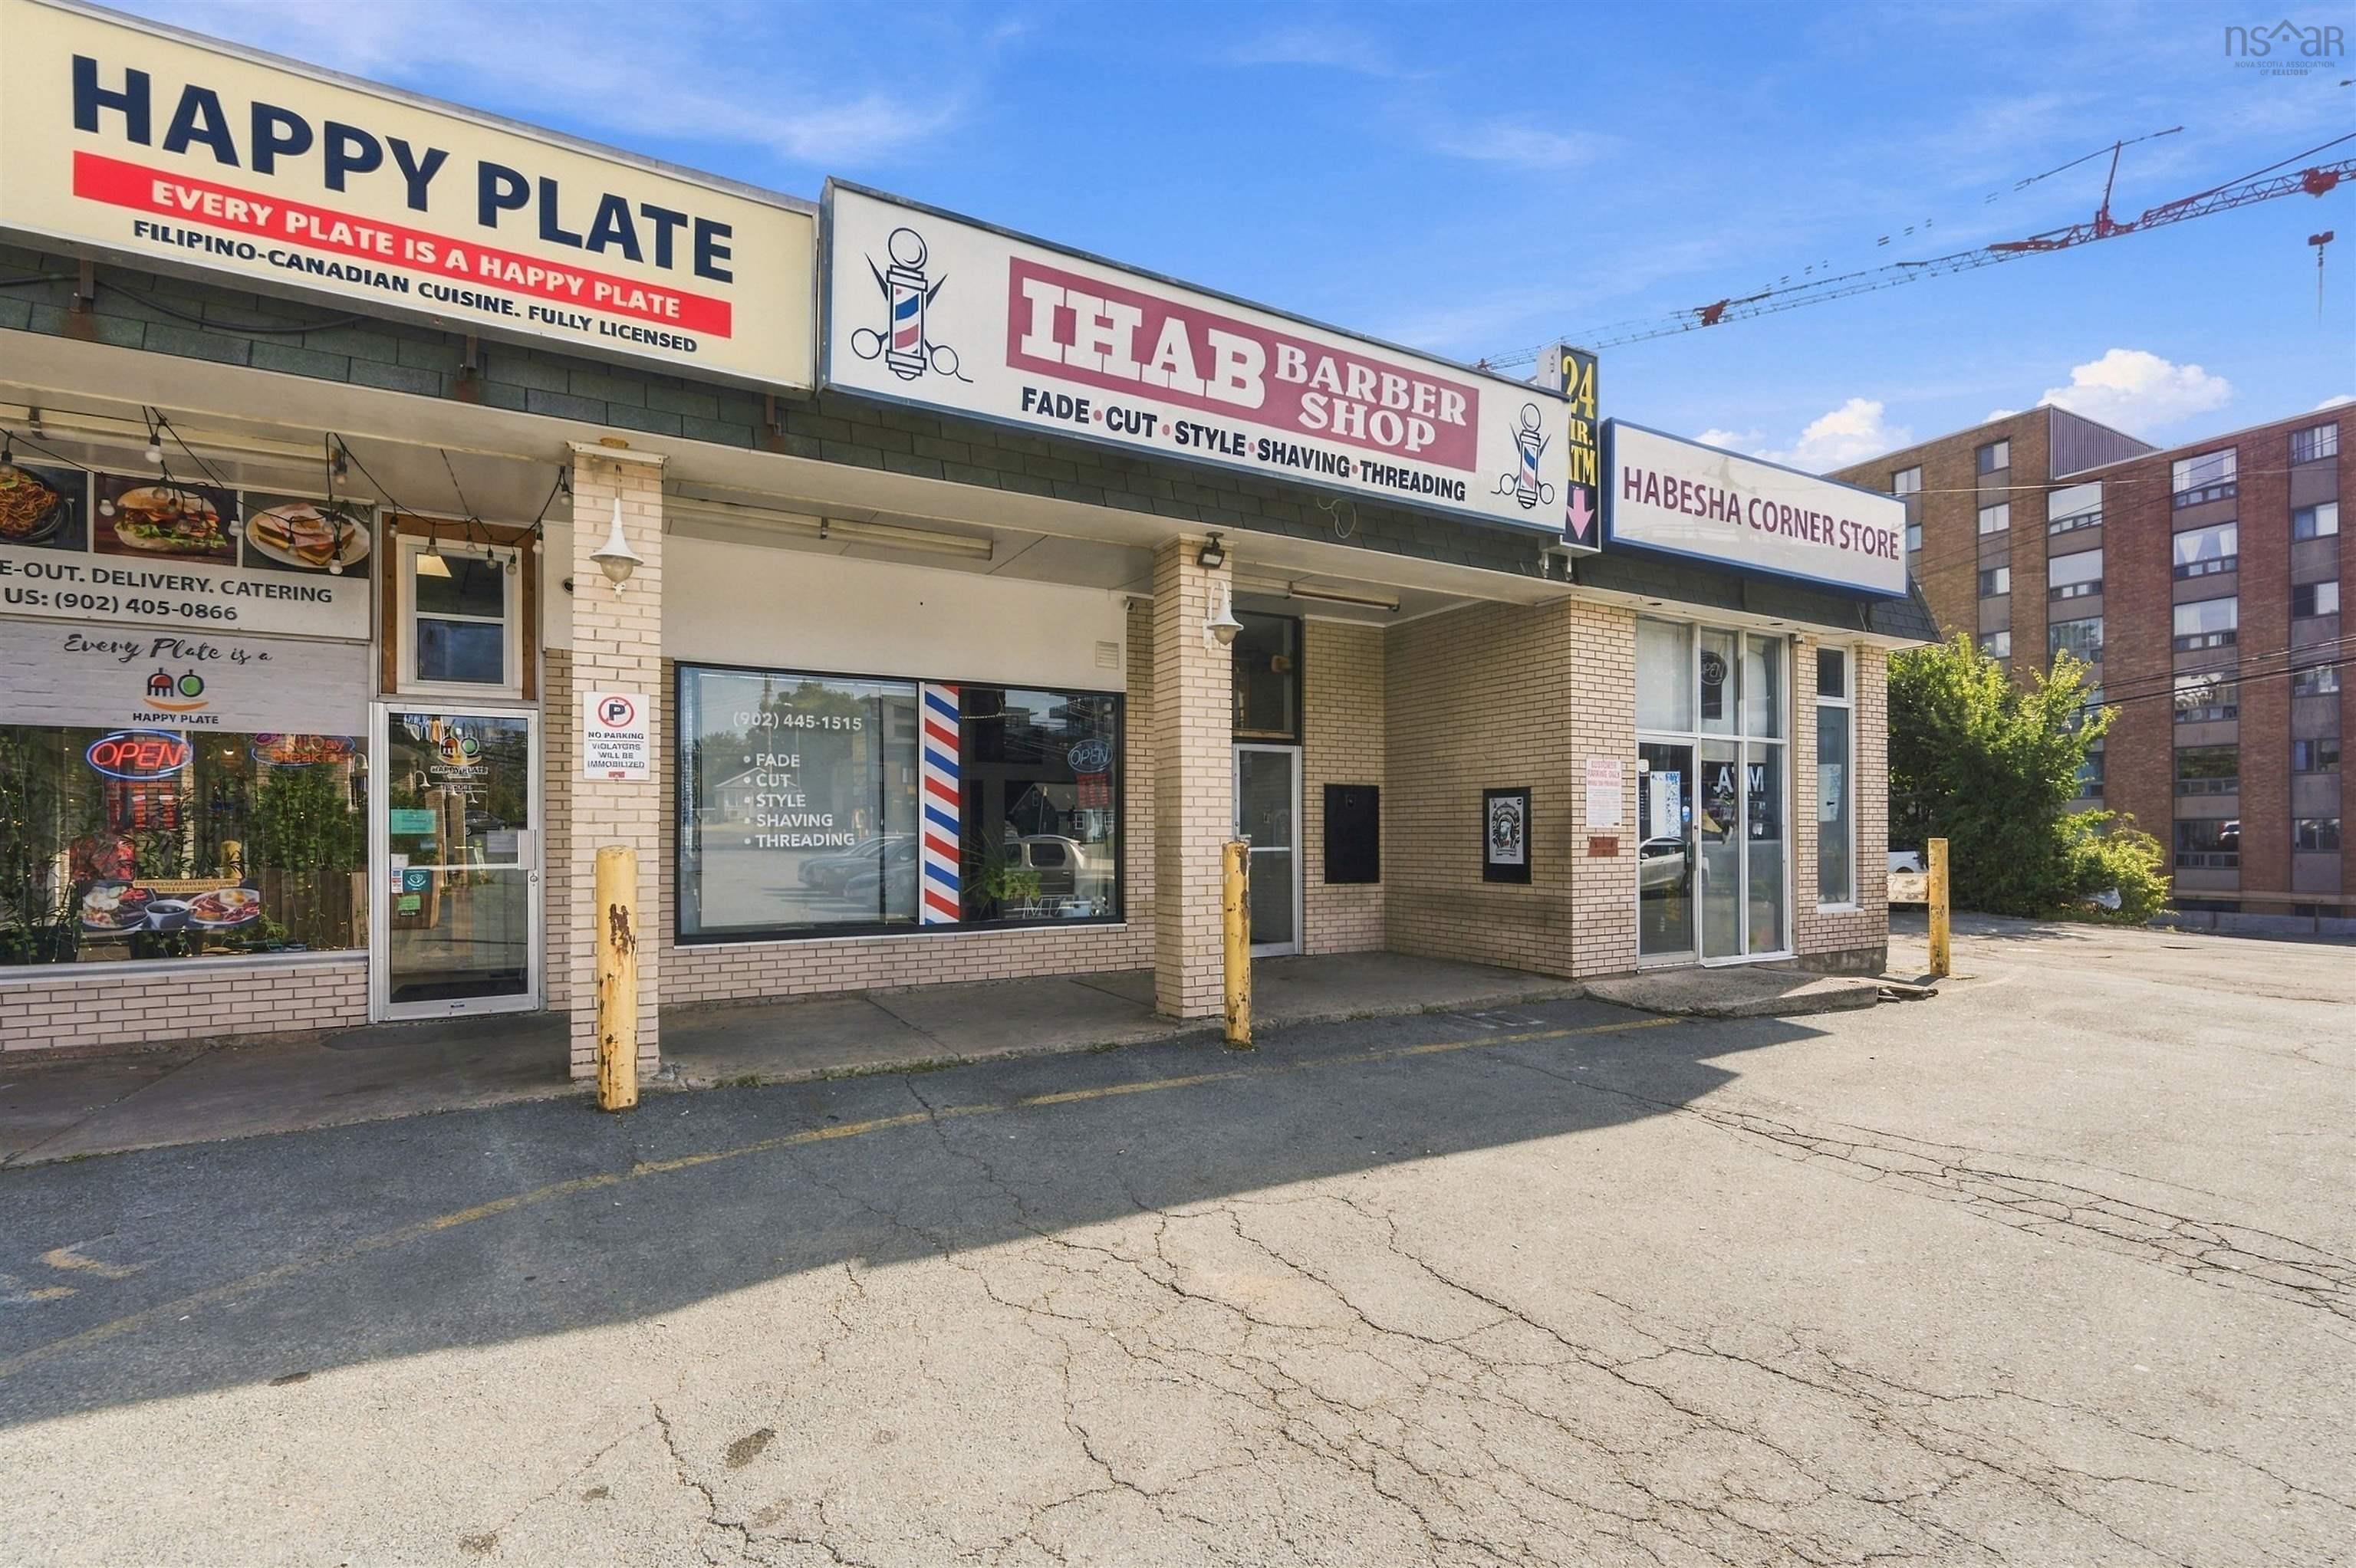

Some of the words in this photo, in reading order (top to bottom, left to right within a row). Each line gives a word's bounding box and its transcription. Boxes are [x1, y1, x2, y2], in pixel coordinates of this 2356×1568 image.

[73, 54, 449, 212] HAPPY
[476, 160, 734, 284] PLATE
[152, 181, 271, 227] EVERY
[285, 212, 396, 257] PLATE
[404, 239, 438, 265] IS
[444, 249, 470, 273] A
[479, 256, 586, 301] HAPPY
[594, 281, 681, 318] PLATE
[133, 219, 410, 293] FILIPINO-CANADIAN
[417, 282, 522, 319] CUISINE.
[528, 305, 594, 332] FULLY
[599, 322, 698, 353] LICENSED
[1020, 277, 1266, 409] IHAB
[1275, 343, 1466, 426] BARBER
[1562, 355, 1594, 419] 24
[1298, 392, 1436, 452] SHOP
[1022, 386, 1090, 423] FADE
[1106, 408, 1157, 437] CUT
[1174, 422, 1245, 456] STYLE
[1257, 438, 1351, 478] SHAVING
[1360, 461, 1466, 501] THREADING
[1568, 444, 1596, 487] TM
[1624, 466, 1741, 524] HABESHA
[1748, 498, 1834, 547] CORNER
[1840, 520, 1900, 560] STORE
[91, 568, 215, 594] DELIVERY.
[220, 580, 333, 603] CATERING
[5, 588, 48, 606] US:
[54, 593, 120, 614] (902)
[125, 598, 238, 621] 405-0866
[64, 633, 143, 662] Every
[150, 637, 222, 662] Plate
[230, 647, 252, 665] is
[258, 652, 272, 662] a
[133, 712, 176, 724] HAPPY
[181, 715, 219, 725] PLATE
[732, 712, 779, 729] (902)
[783, 714, 862, 731] 445-1515
[604, 731, 644, 740] PARKING
[91, 741, 186, 768] OPEN
[587, 760, 645, 768] IMMOBILIZED
[755, 754, 801, 768] FADE
[1071, 748, 1109, 765] OPEN
[756, 774, 791, 787] CUT
[1716, 767, 1764, 793] AM
[756, 794, 806, 808] STYLE
[756, 813, 834, 828] SHAVING
[755, 833, 855, 848] THREADING
